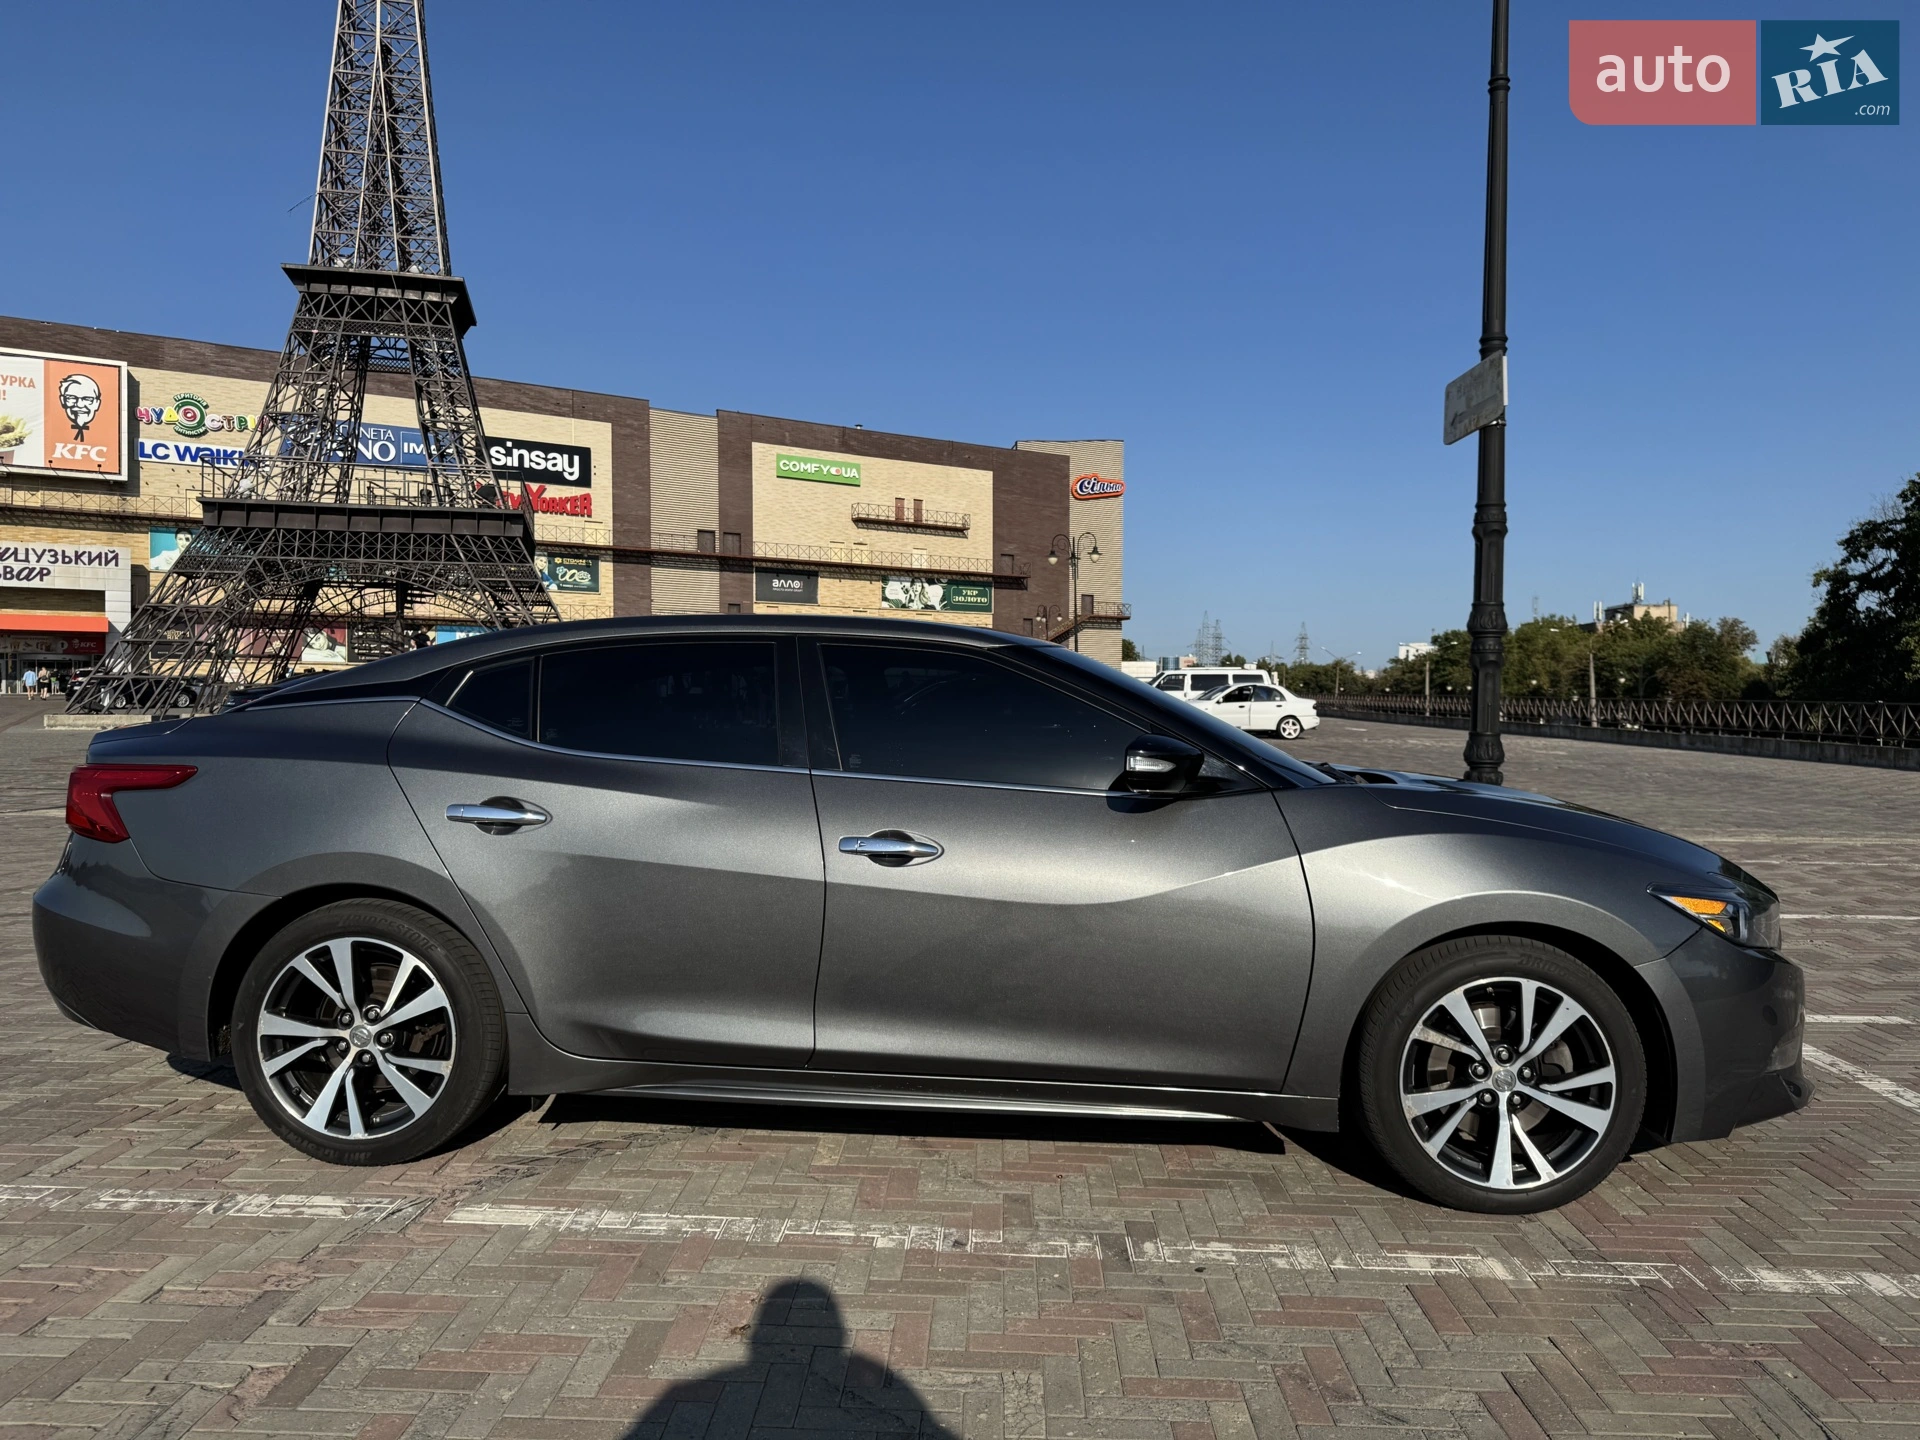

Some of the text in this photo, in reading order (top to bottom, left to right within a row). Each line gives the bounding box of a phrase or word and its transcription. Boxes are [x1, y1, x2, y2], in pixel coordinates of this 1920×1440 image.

[52, 442, 107, 462] KFC
[139, 441, 170, 460] LC
[489, 440, 580, 481] sinsay
[780, 459, 830, 475] COMFY
[1076, 477, 1123, 495] Сільпо
[525, 484, 592, 517] YORKER
[0, 565, 51, 582] ВАР
[952, 595, 988, 603] ЗОЛОТО
